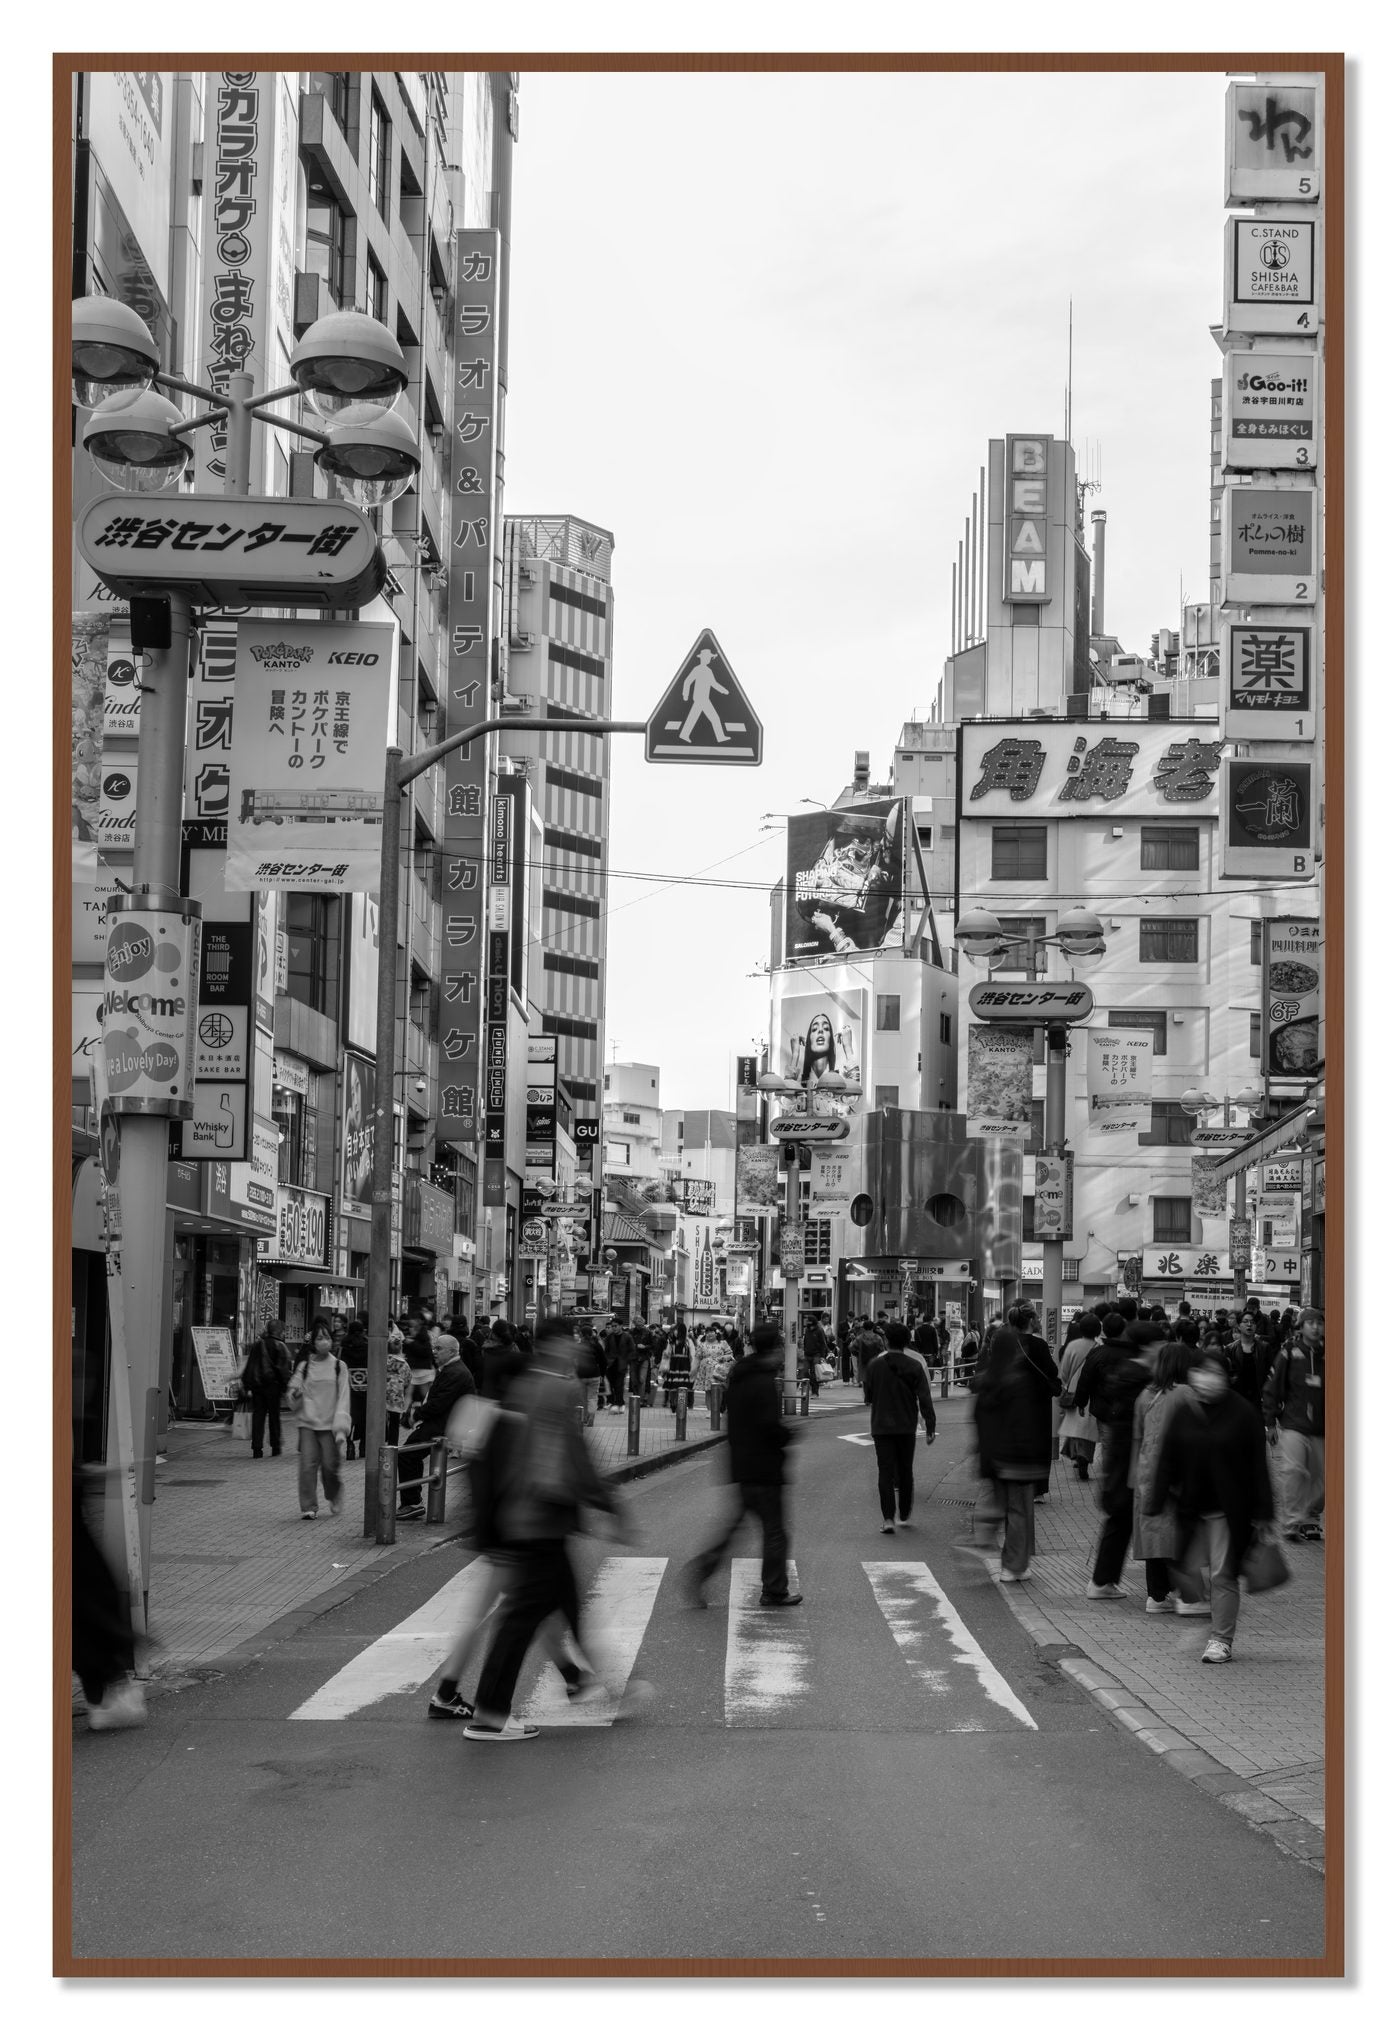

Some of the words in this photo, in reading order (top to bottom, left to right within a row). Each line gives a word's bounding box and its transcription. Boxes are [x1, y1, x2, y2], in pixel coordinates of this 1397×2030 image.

[216, 88, 258, 235] カラオケ
[1298, 178, 1312, 194] 5
[1251, 228, 1299, 239] C.STAND
[1251, 271, 1299, 283] SHISHA
[1251, 283, 1299, 292] CAFE&BAR
[1297, 312, 1310, 328] 4
[1250, 375, 1307, 392] Goo-it!
[1242, 396, 1304, 406] 渋谷宇田川町店
[1237, 423, 1309, 436] 全身もみほぐし
[1296, 447, 1308, 465] 3
[1012, 440, 1046, 593] BEAM
[94, 516, 359, 556] 渋谷センター街
[1295, 582, 1308, 599] 2
[264, 660, 300, 669] KANTO
[328, 652, 379, 666] KEIO
[1241, 634, 1295, 689] 薬
[1235, 692, 1300, 708] マツモトキヨシ
[269, 690, 285, 736] 冒険へ
[108, 718, 134, 728] 渋谷店
[288, 690, 307, 769] カントーの
[310, 690, 329, 769] ポケパーク
[333, 691, 351, 754] 京王線で
[1294, 719, 1304, 736] 1
[969, 736, 1225, 803] 角海老
[1236, 779, 1299, 831] 一蘭
[496, 800, 506, 838] kimono
[104, 833, 131, 843] 渋谷店
[255, 862, 349, 877] 渋谷センター街
[1293, 856, 1306, 872] B
[211, 935, 226, 943] THE
[794, 941, 819, 949] SALOMON
[109, 936, 151, 974] Enjoy
[210, 984, 225, 992] BAR
[104, 989, 185, 1017] Welcome
[976, 992, 1085, 1006] 渋谷センター街
[1270, 1001, 1300, 1022] 6F
[134, 1013, 155, 1033] Shibuya
[122, 1051, 154, 1072] Lovely
[156, 1053, 177, 1067] Day!
[194, 1122, 228, 1133] Whisky
[577, 1126, 597, 1137] GU
[774, 1122, 839, 1132] 渋谷センター街
[1100, 1121, 1138, 1131] 渋谷センター街
[193, 1132, 214, 1141] Bank
[915, 1267, 944, 1275] 田川交番
[1157, 1252, 1221, 1275] 兆楽
[700, 1297, 713, 1305] HALL
